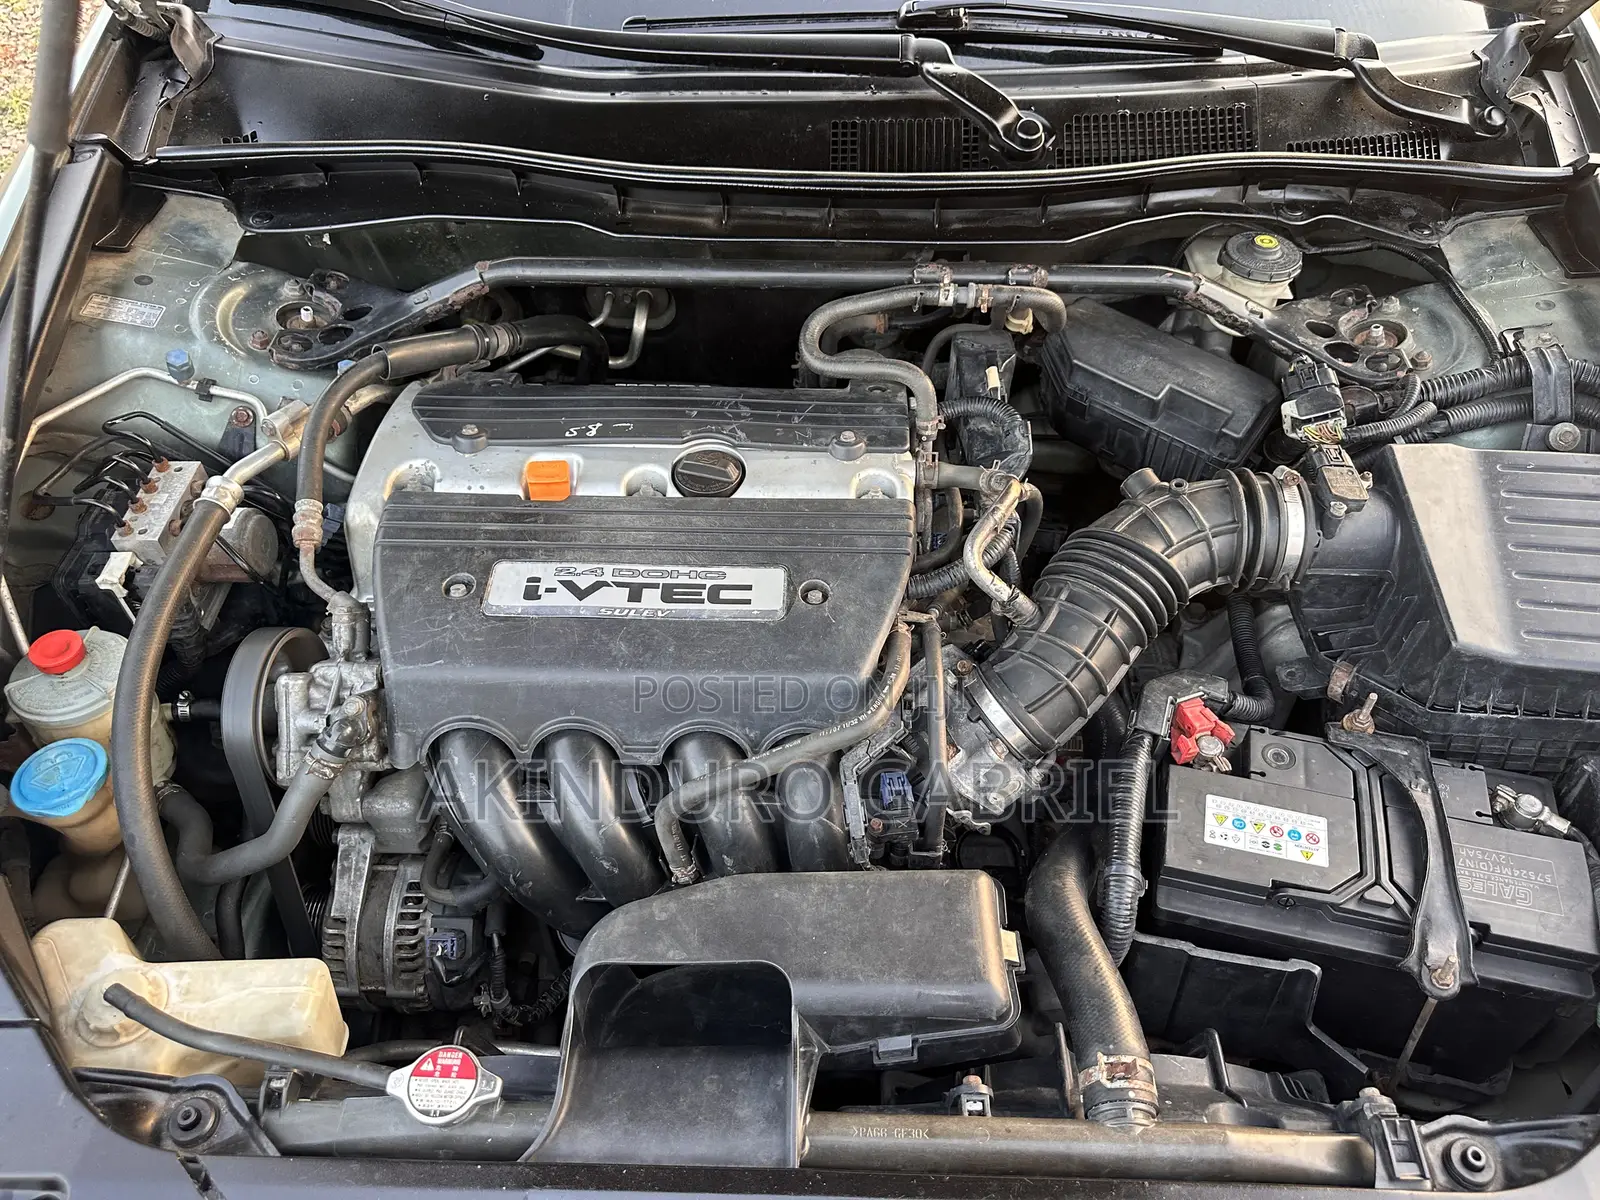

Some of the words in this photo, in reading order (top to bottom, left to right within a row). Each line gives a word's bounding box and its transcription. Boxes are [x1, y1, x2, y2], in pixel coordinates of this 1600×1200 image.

[554, 566, 605, 578] 2.4
[612, 567, 727, 580] DOHC
[522, 576, 753, 605] i-VTEC
[597, 607, 671, 618] SULEV
